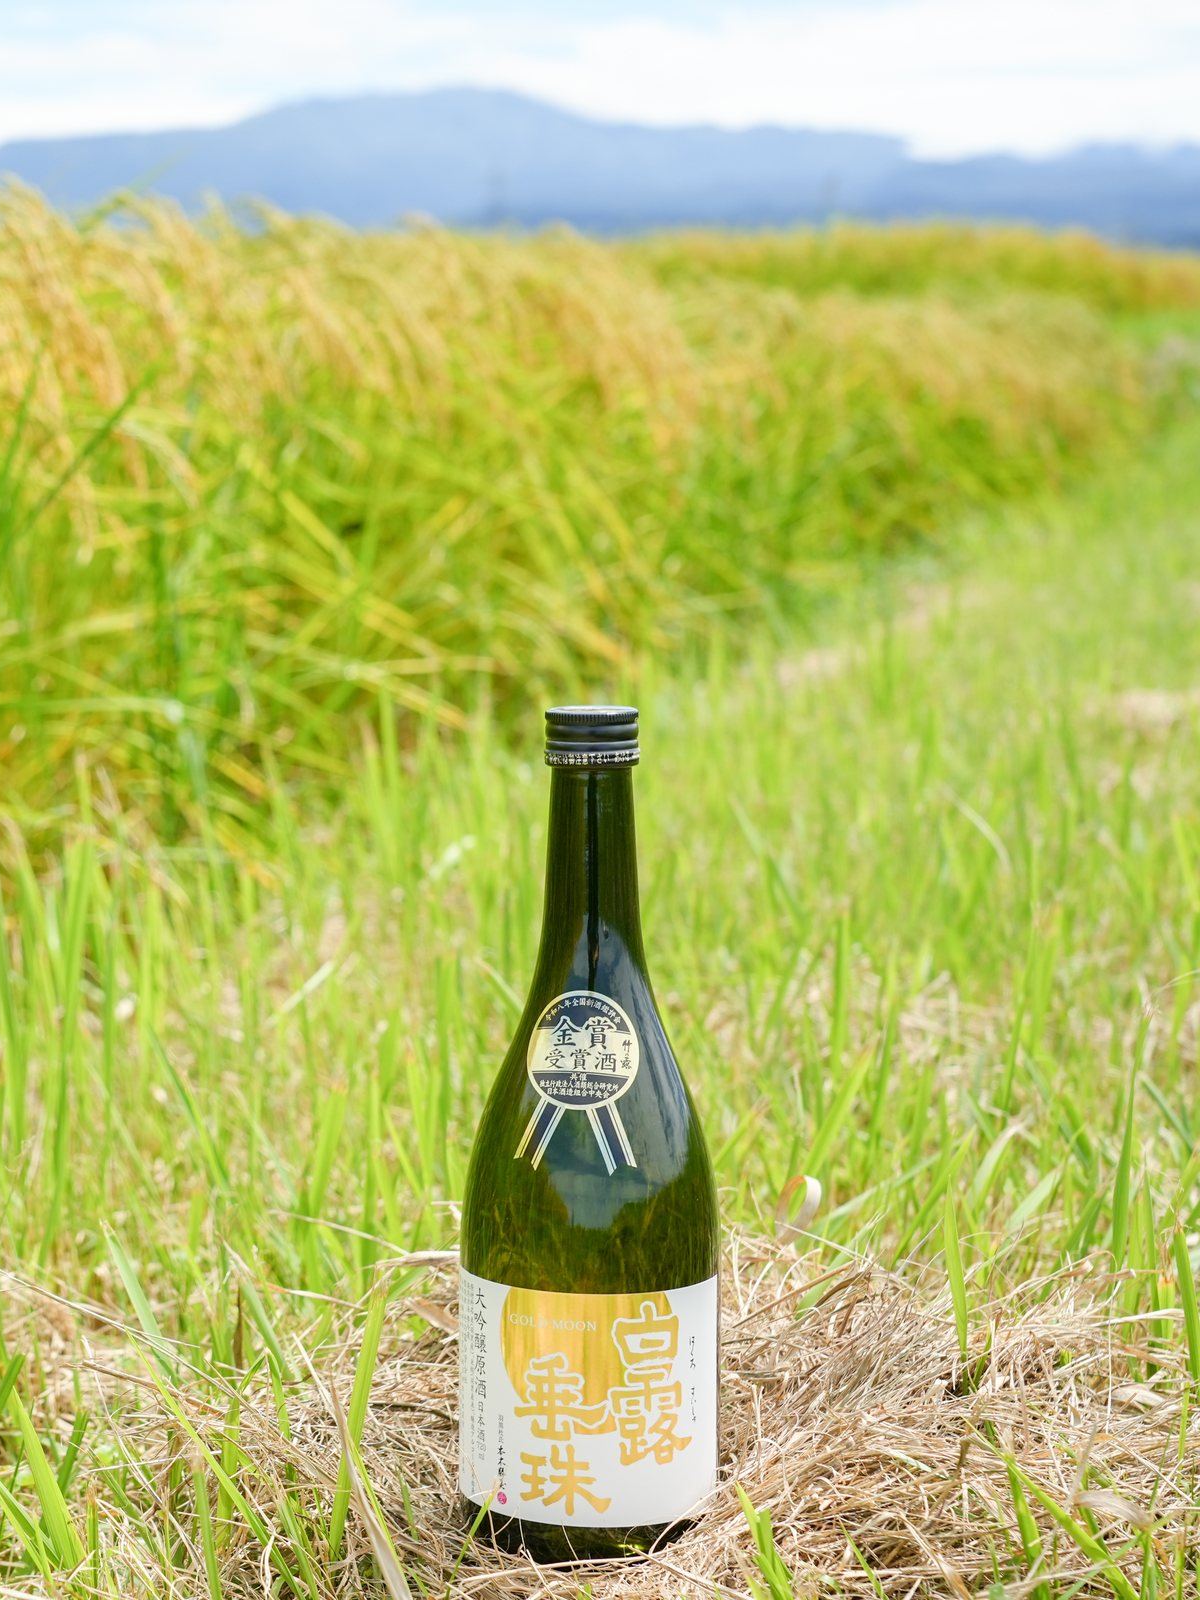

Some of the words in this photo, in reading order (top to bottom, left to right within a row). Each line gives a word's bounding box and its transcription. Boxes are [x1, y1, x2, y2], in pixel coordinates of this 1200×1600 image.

[552, 1017, 615, 1050] 金賞
[545, 1048, 617, 1072] 受賞酒
[509, 1312, 548, 1330] GOLD
[551, 1318, 597, 1332] MOON
[609, 1300, 692, 1466] 白露
[513, 1353, 613, 1517] 垂珠
